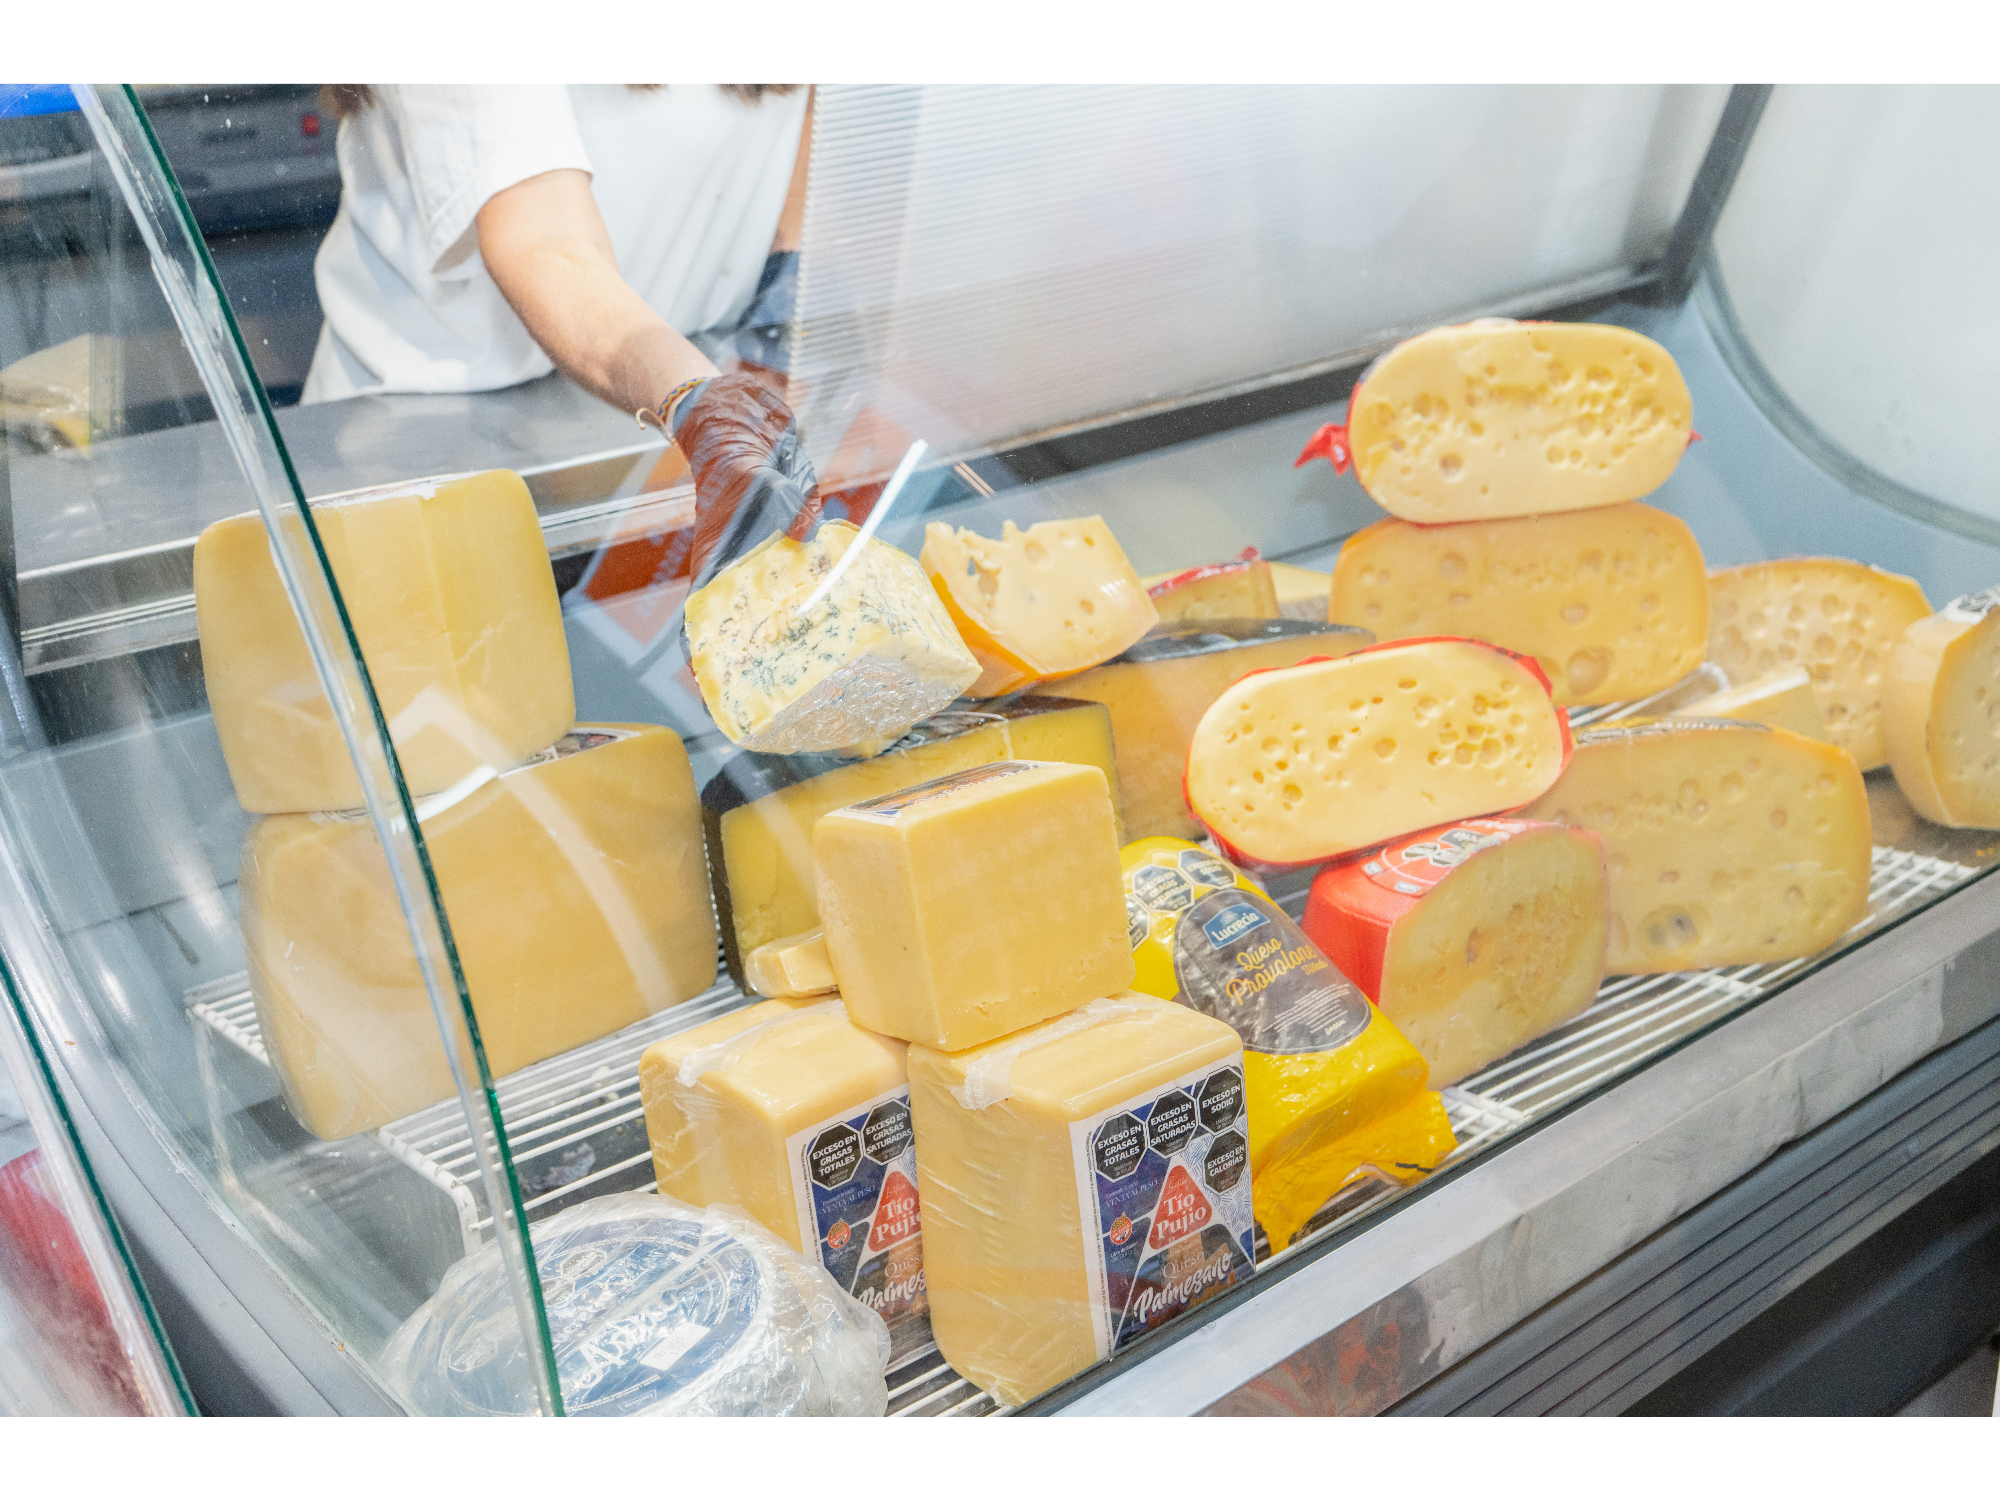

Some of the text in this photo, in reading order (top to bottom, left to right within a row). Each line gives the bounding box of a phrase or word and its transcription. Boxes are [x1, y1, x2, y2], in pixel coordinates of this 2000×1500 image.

[1211, 912, 1260, 942] Lucrecia
[1237, 938, 1282, 972] Queso
[1226, 944, 1318, 1006] Provolone
[1202, 1084, 1241, 1109] EXCESO EN
[1211, 1097, 1234, 1114] SODIO
[866, 1111, 908, 1135] EXCESO EN
[1150, 1102, 1192, 1126] EXCESO EN
[1157, 1114, 1189, 1133] GRASAS
[866, 1128, 912, 1154] SATURADAS
[873, 1122, 905, 1141] GRASAS
[1098, 1124, 1142, 1150] EXCESO EN
[1150, 1120, 1196, 1147] SATURADAS
[812, 1134, 857, 1160] EXCESO EN
[820, 1146, 853, 1167] GRASAS
[1104, 1146, 1140, 1168] TOTALES
[1105, 1136, 1138, 1157] GRASAS
[1207, 1145, 1245, 1170] EXCESO EN
[819, 1154, 856, 1177] TOTALES
[1209, 1154, 1244, 1177] CALORÍAS
[857, 1185, 876, 1198] PESO
[882, 1197, 915, 1221] Tío
[1163, 1193, 1195, 1217] Tío
[1156, 1206, 1207, 1241] Pujio
[1163, 1251, 1204, 1279] Queso
[859, 1268, 926, 1312] Parmes
[1134, 1252, 1233, 1324] Parmesano
